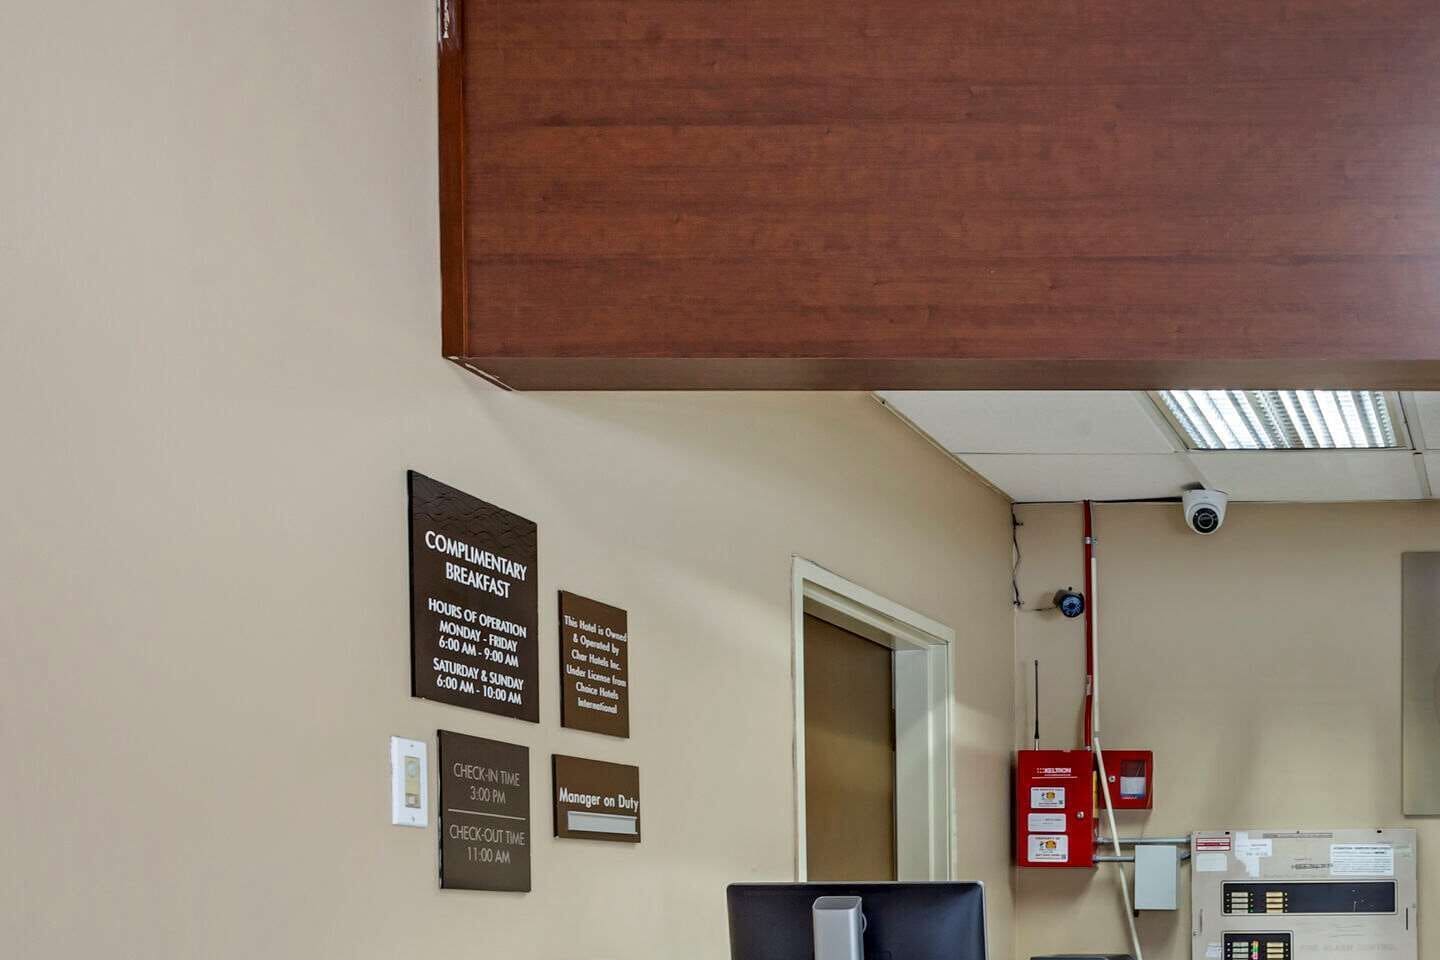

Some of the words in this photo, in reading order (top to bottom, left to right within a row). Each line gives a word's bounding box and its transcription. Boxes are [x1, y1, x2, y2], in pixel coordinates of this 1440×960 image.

[425, 530, 527, 581] COMPLIMENTARY
[446, 561, 511, 598] BREAKFAST
[428, 597, 462, 619] HOURS
[463, 609, 478, 623] OF
[479, 613, 527, 638] OPERATION
[564, 615, 578, 628] This
[579, 619, 597, 633] Hotel
[597, 625, 604, 635] is
[605, 627, 627, 642] Owned
[439, 620, 481, 642] MONDAY
[488, 633, 518, 652] FRIDAY
[572, 633, 579, 643] &
[580, 634, 610, 652] Operated
[611, 643, 620, 656] by
[438, 635, 460, 652] 6:00
[461, 641, 477, 656] AM
[483, 647, 504, 663] 9:00
[504, 654, 519, 667] AM
[588, 653, 609, 669] Hotels
[610, 660, 622, 671] Inc.
[433, 657, 479, 680] SATURDAY
[480, 669, 488, 682] &
[488, 671, 524, 690] SUNDAY
[566, 663, 586, 678] Under
[587, 669, 611, 684] License
[612, 675, 627, 688] from
[436, 674, 458, 690] 6:00
[459, 679, 475, 694] AM
[483, 685, 507, 701] 10:00
[507, 691, 522, 704] AM
[576, 681, 599, 696] Choice
[599, 687, 619, 700] Hotels
[578, 697, 618, 714] International
[453, 762, 498, 783] CHECK-IN
[500, 770, 520, 787] TIME
[470, 785, 491, 802] 3:00
[492, 788, 506, 804] PM
[559, 786, 600, 809] Manager
[603, 796, 616, 807] on
[618, 794, 639, 813] Duty
[449, 824, 503, 843] CHECK-OUT
[505, 830, 526, 846] TIME
[467, 846, 493, 863] 11:00
[494, 848, 511, 864] AM
